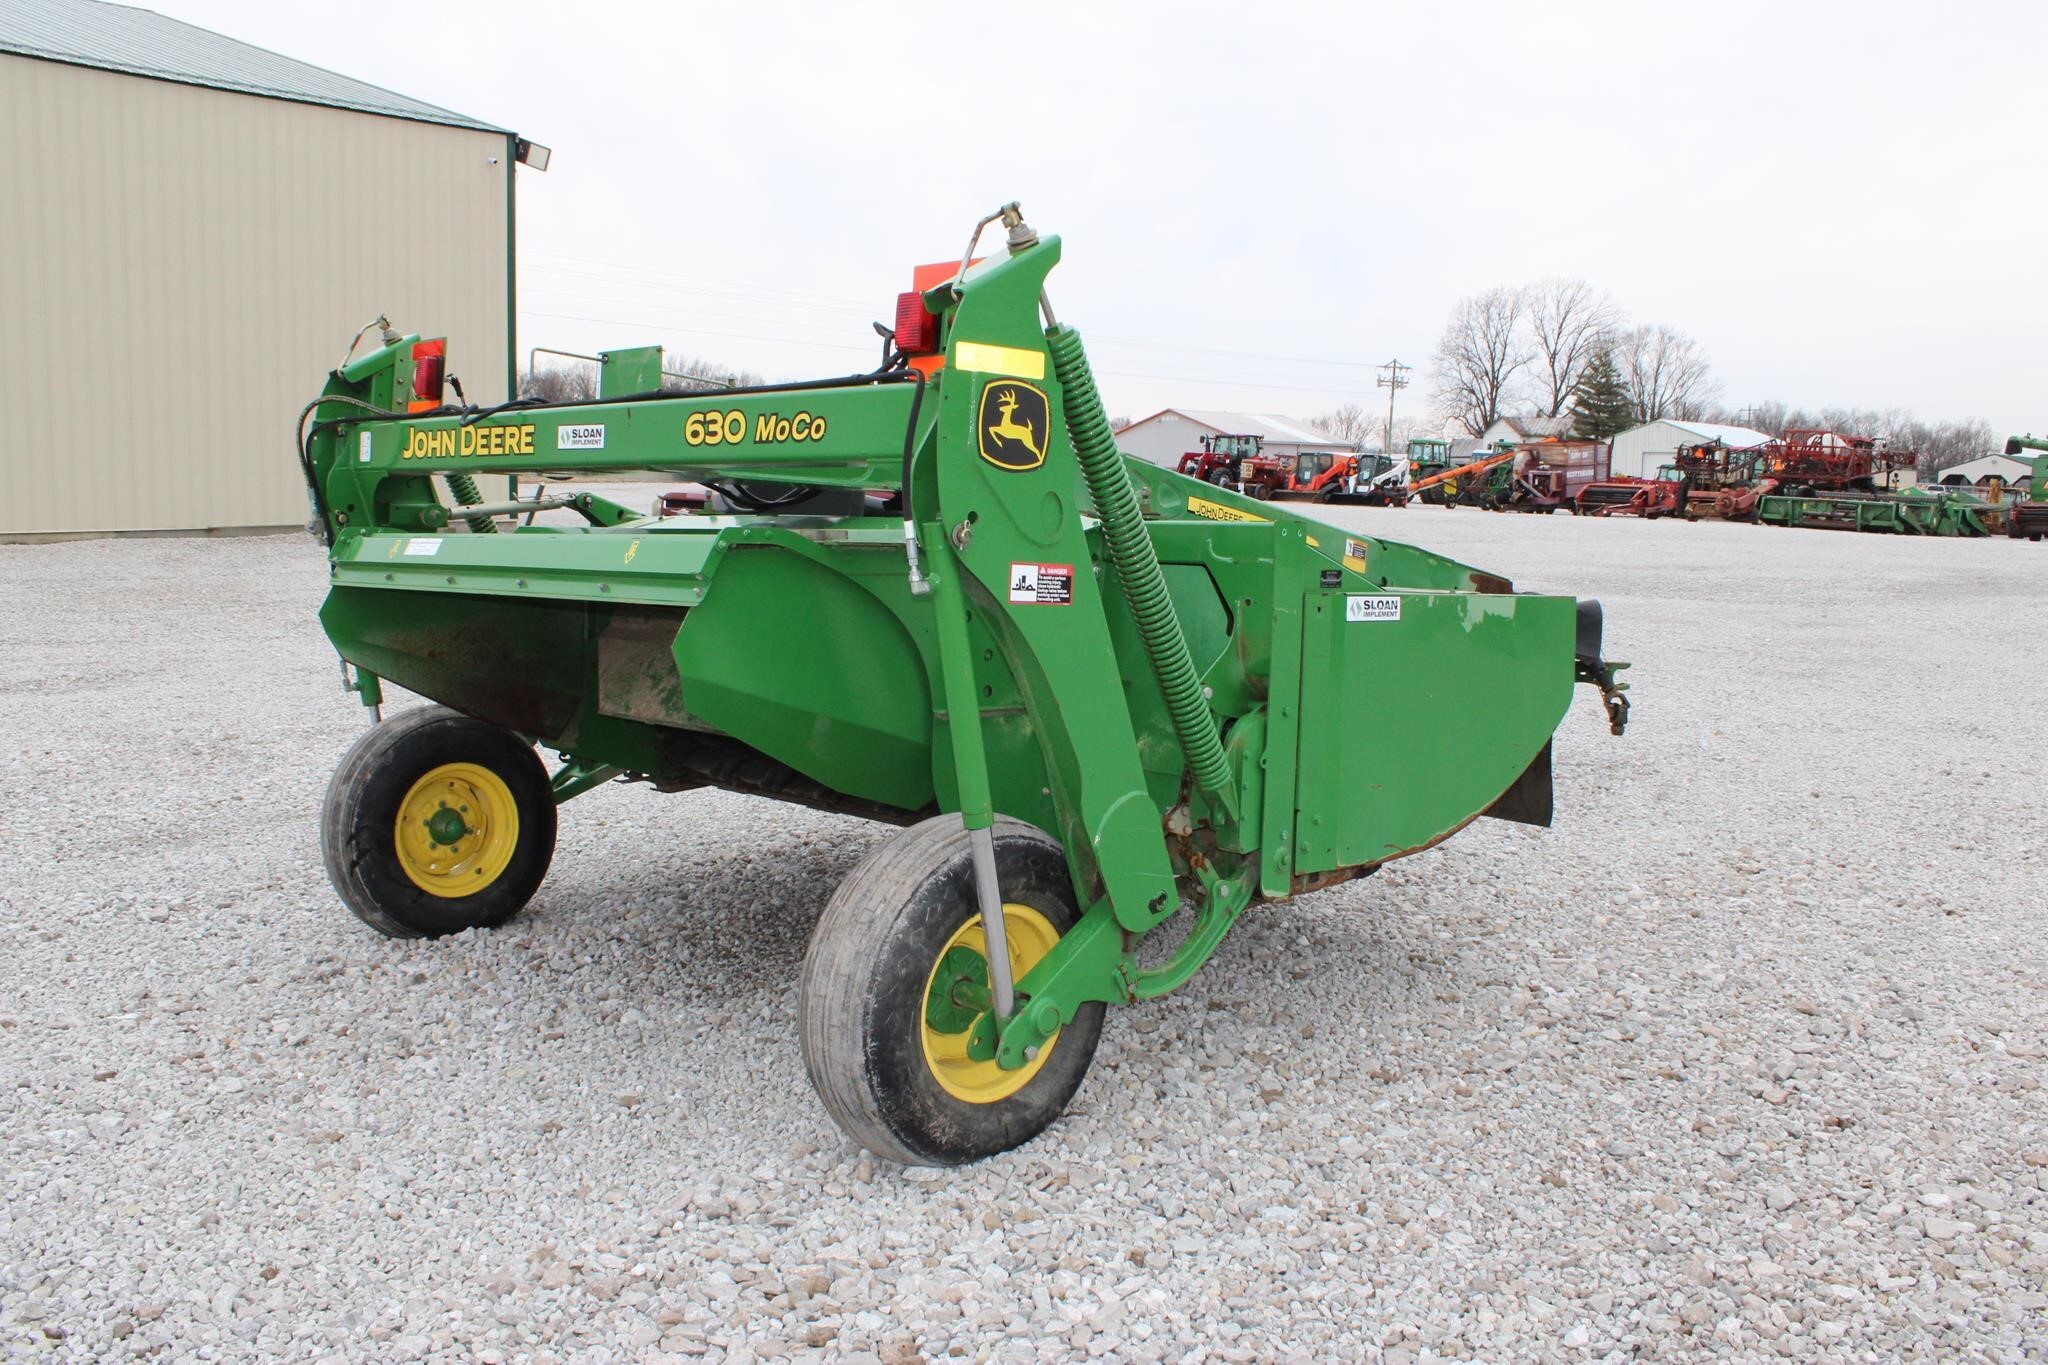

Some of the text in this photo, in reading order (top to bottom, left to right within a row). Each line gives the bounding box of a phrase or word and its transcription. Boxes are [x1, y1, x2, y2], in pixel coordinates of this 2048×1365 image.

[571, 428, 602, 439] SLOAN
[685, 409, 827, 447] 630 MoCo
[402, 426, 456, 460] JOHN
[459, 423, 536, 457] DEERE
[1363, 600, 1398, 611] SLOAN
